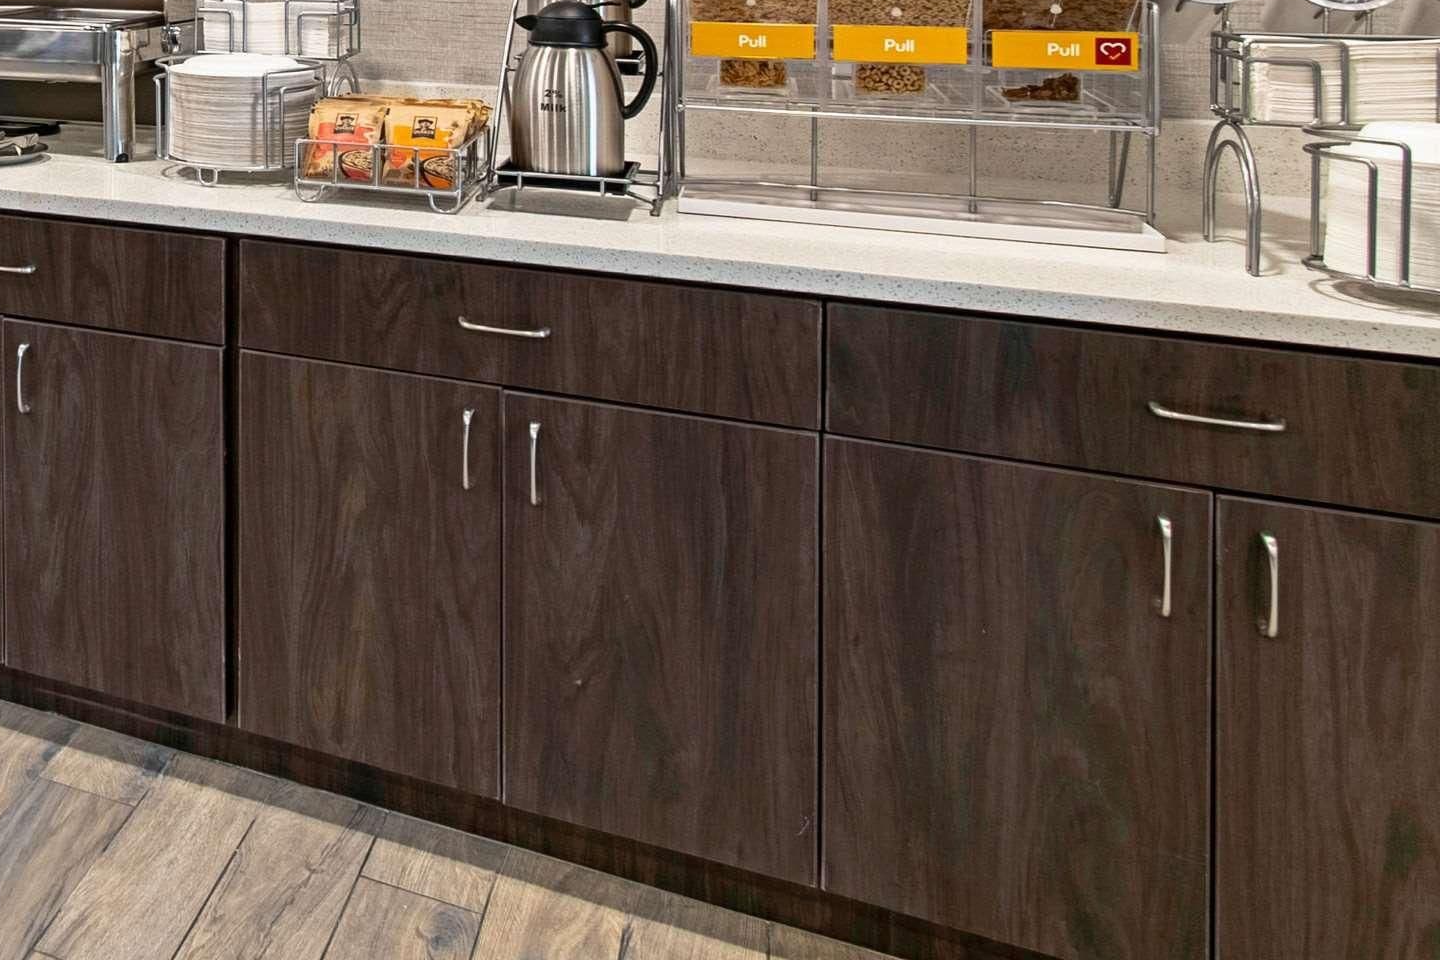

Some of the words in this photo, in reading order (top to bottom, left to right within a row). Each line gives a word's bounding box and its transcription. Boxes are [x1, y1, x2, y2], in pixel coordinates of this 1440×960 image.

[738, 34, 767, 48] Pull
[884, 39, 915, 52] Pull
[1047, 42, 1080, 57] Pull
[544, 89, 563, 98] 2%
[540, 103, 566, 113] Milk
